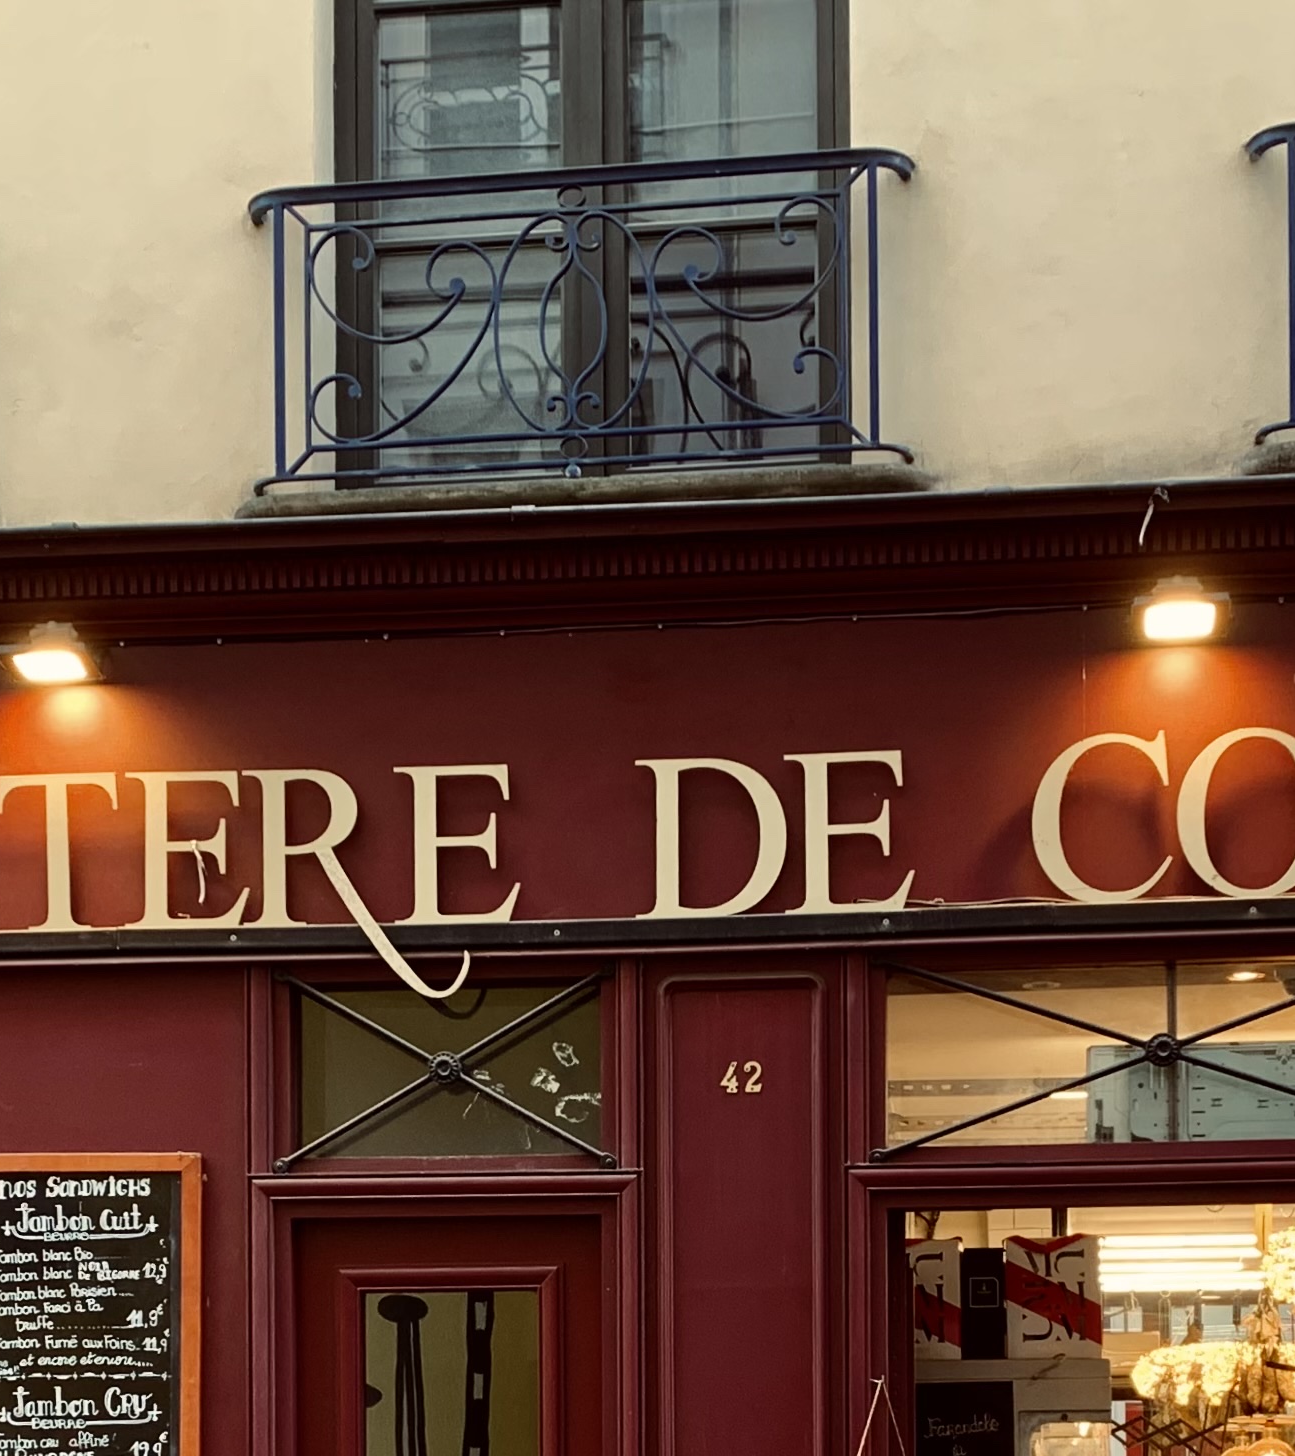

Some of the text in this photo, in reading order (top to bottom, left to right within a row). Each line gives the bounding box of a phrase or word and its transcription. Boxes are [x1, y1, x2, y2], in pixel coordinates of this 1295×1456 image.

[635, 748, 914, 919] DE
[720, 1061, 762, 1093] 42
[43, 1249, 72, 1261] blanc
[74, 1247, 93, 1260] Bio
[43, 1267, 73, 1279] blanc
[38, 1287, 66, 1298] blanc
[13, 1386, 98, 1417] Jambon
